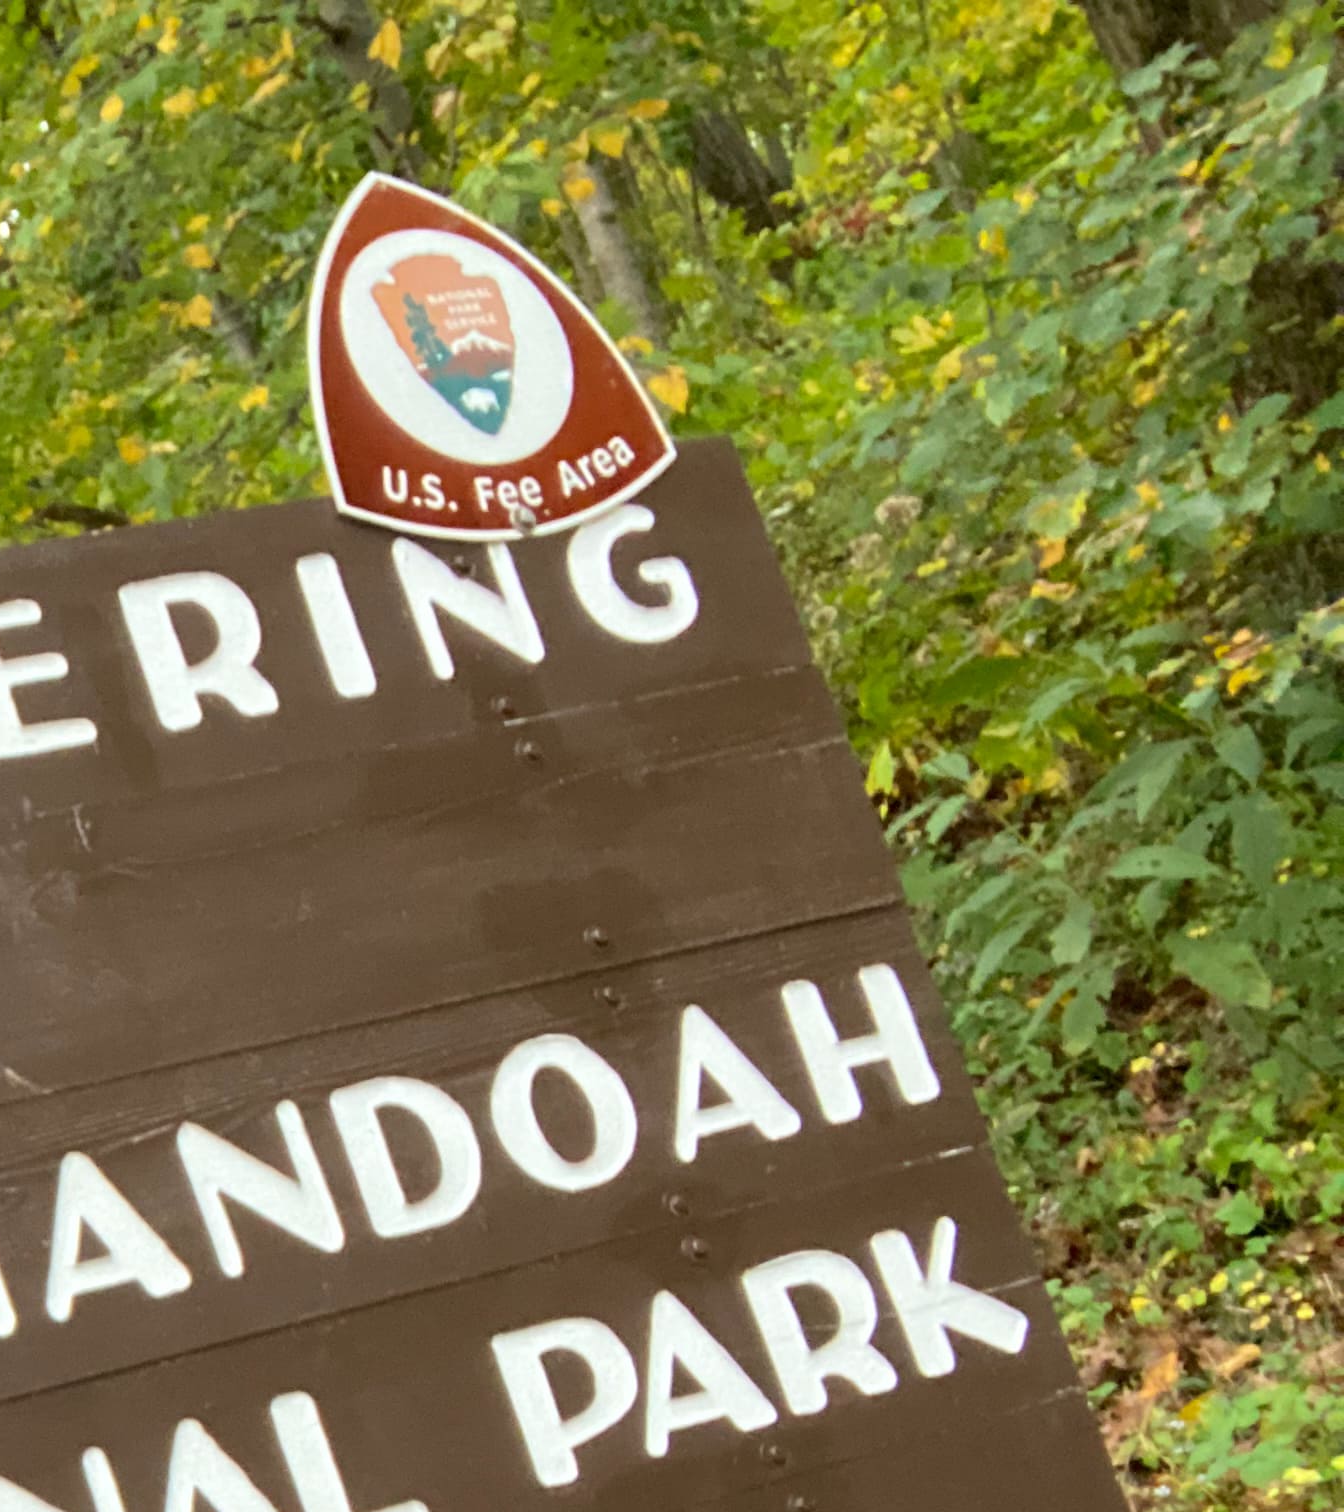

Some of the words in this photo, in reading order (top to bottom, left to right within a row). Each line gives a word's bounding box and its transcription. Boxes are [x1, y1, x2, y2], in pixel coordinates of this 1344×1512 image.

[382, 465, 458, 512] U.S.
[474, 475, 543, 512] Fee
[557, 435, 635, 498] Area
[490, 1215, 1030, 1488] PARK
